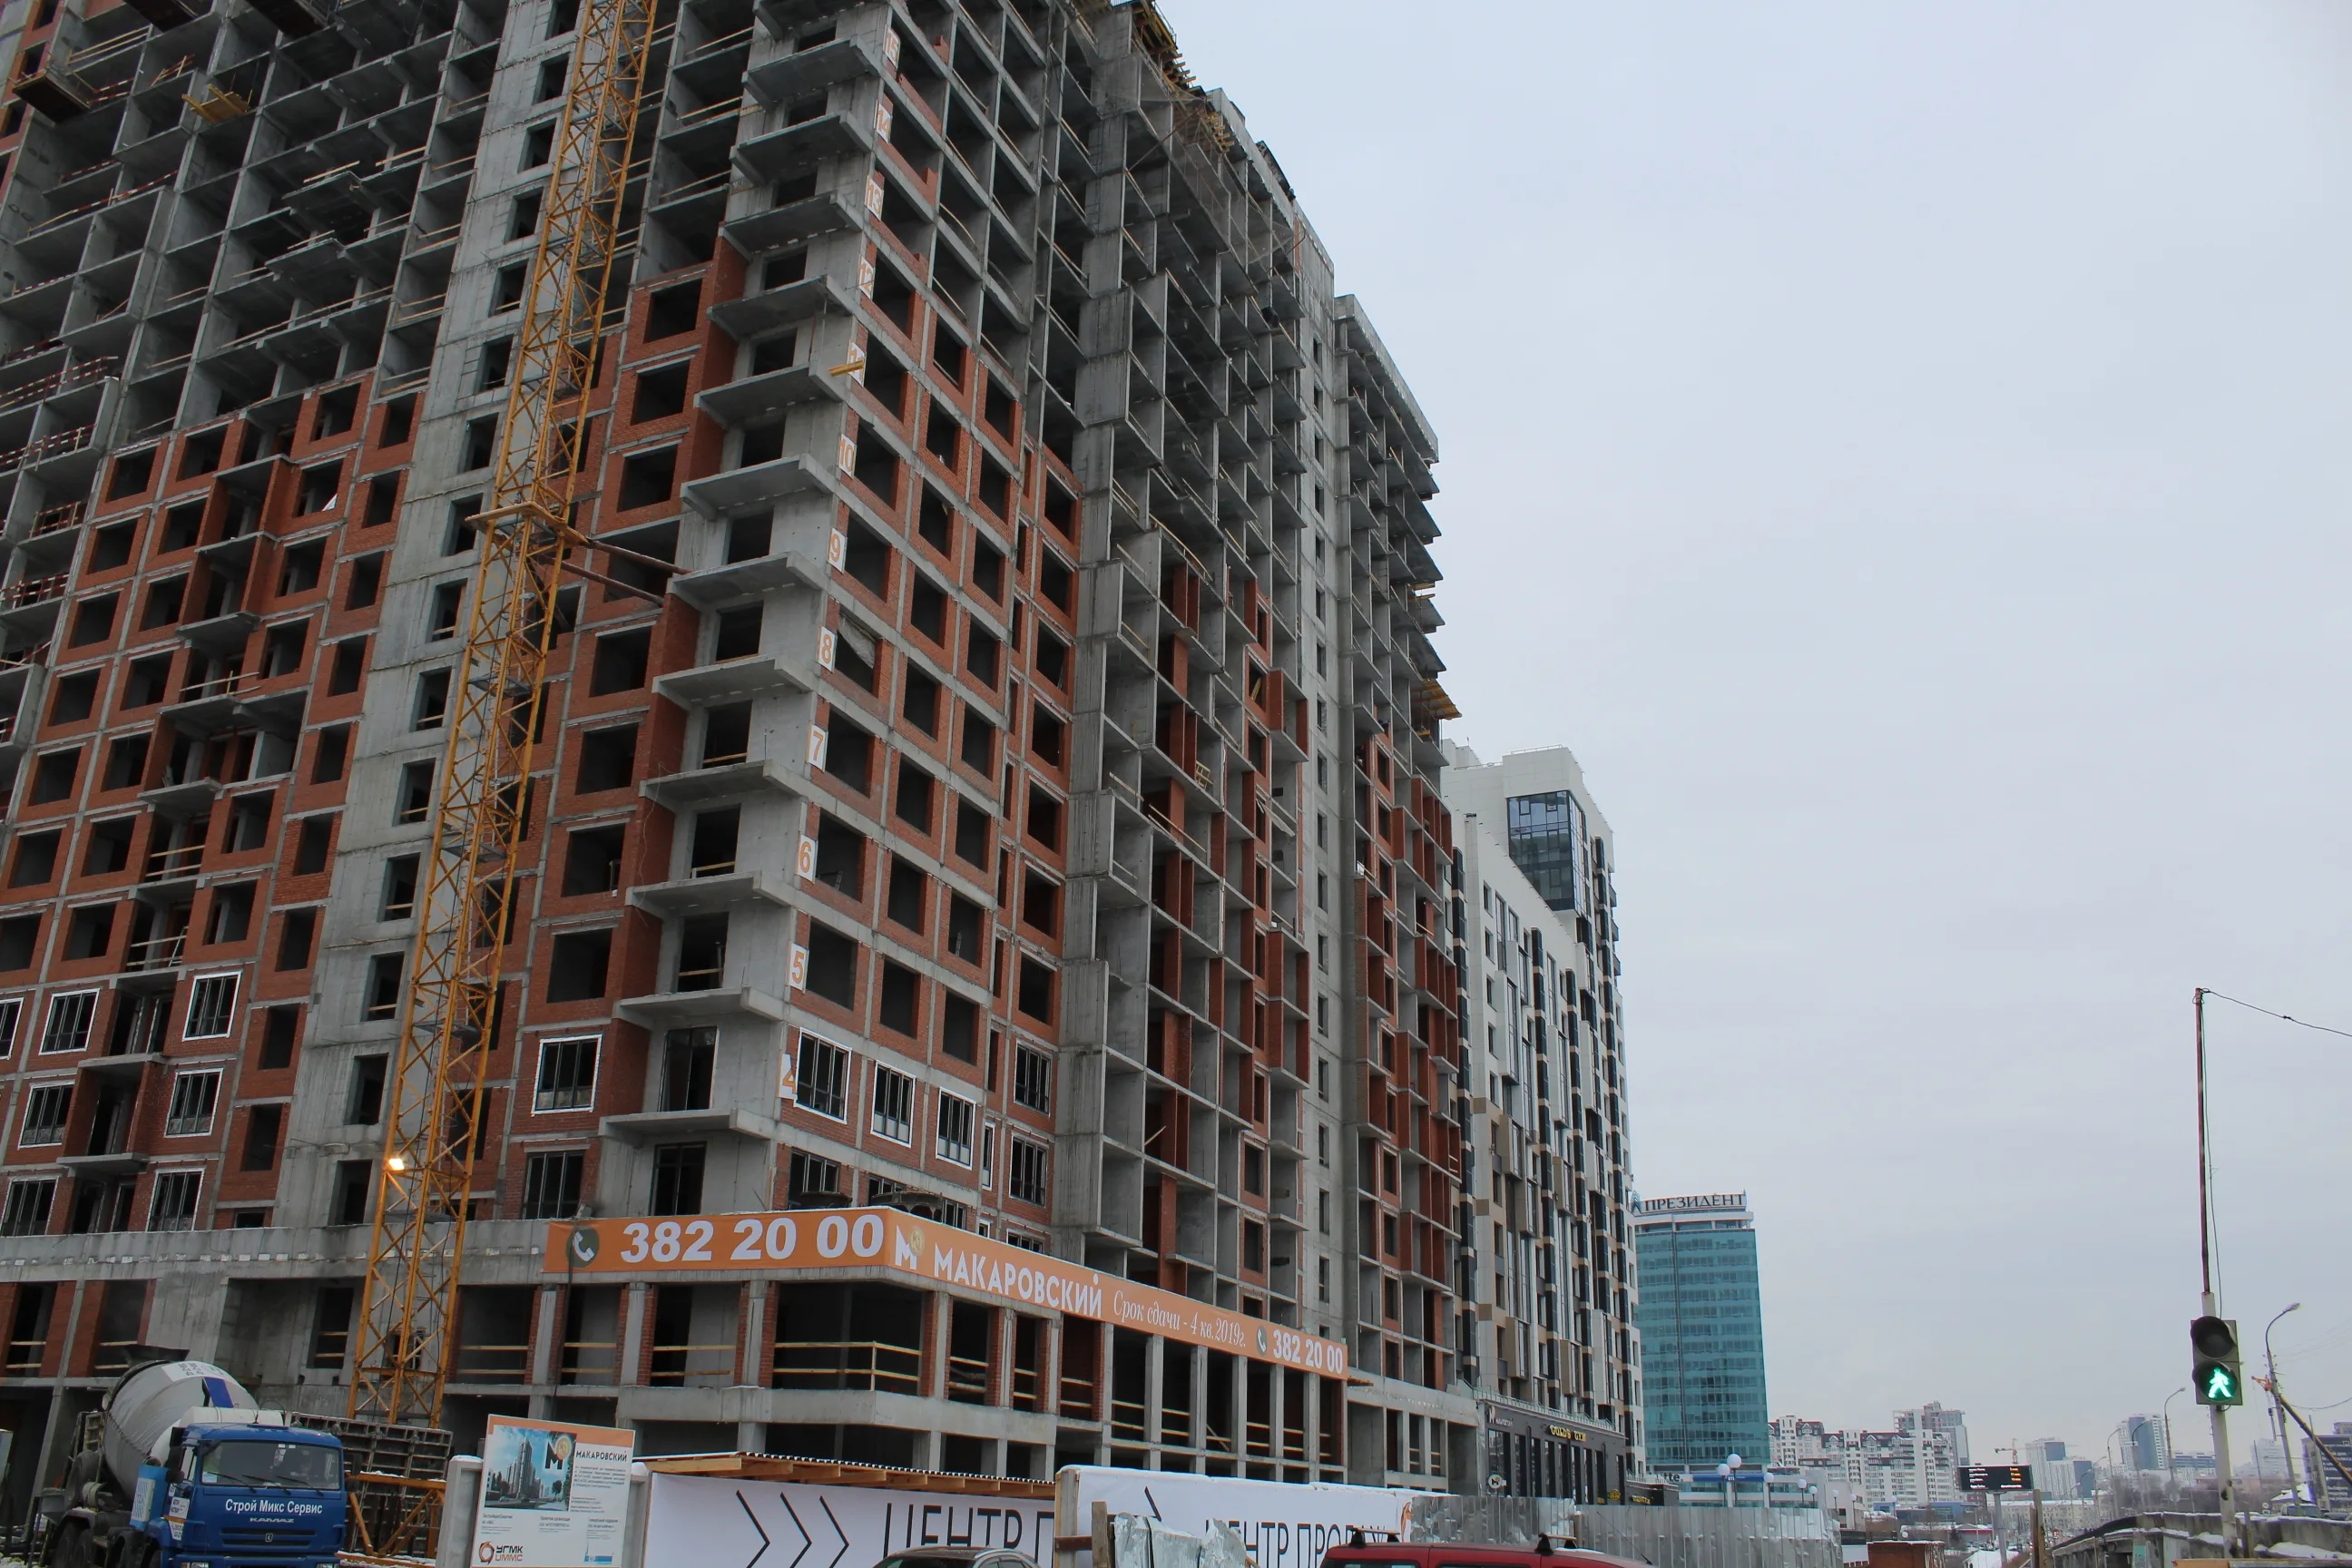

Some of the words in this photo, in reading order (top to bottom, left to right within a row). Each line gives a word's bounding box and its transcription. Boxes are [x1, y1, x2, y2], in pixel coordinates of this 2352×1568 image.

[886, 33, 899, 62] 15
[877, 108, 890, 137] 14
[867, 184, 882, 214] 13
[860, 263, 873, 293] 12
[839, 438, 855, 472] 10
[829, 533, 841, 563] 9
[821, 633, 832, 664] 8
[813, 730, 824, 761] 7
[799, 840, 812, 874] 6
[791, 950, 805, 985] 5
[782, 1069, 797, 1094] 4
[1644, 1194, 1743, 1211] ПРЕЗИДЕНТ
[621, 1220, 714, 1263] 382
[730, 1217, 797, 1260] 20
[817, 1214, 884, 1259] 00
[933, 1241, 1103, 1318] МАКАРОВСКИЙ
[1113, 1289, 1144, 1323] Срок
[1147, 1301, 1181, 1331] сдачи
[1191, 1312, 1199, 1336] 4
[1273, 1329, 1301, 1364] 382
[1305, 1338, 1322, 1369] 20
[1327, 1345, 1343, 1374] 00
[1573, 1430, 1586, 1442] GYM
[575, 1450, 627, 1462] МАКАРОВСКИЙ
[225, 1498, 257, 1514] Строй
[260, 1500, 284, 1513] Микс
[287, 1500, 323, 1516] Сервис
[495, 1544, 524, 1553] УГМК
[495, 1553, 524, 1562] UMMC
[1206, 1520, 1289, 1568] НТР
